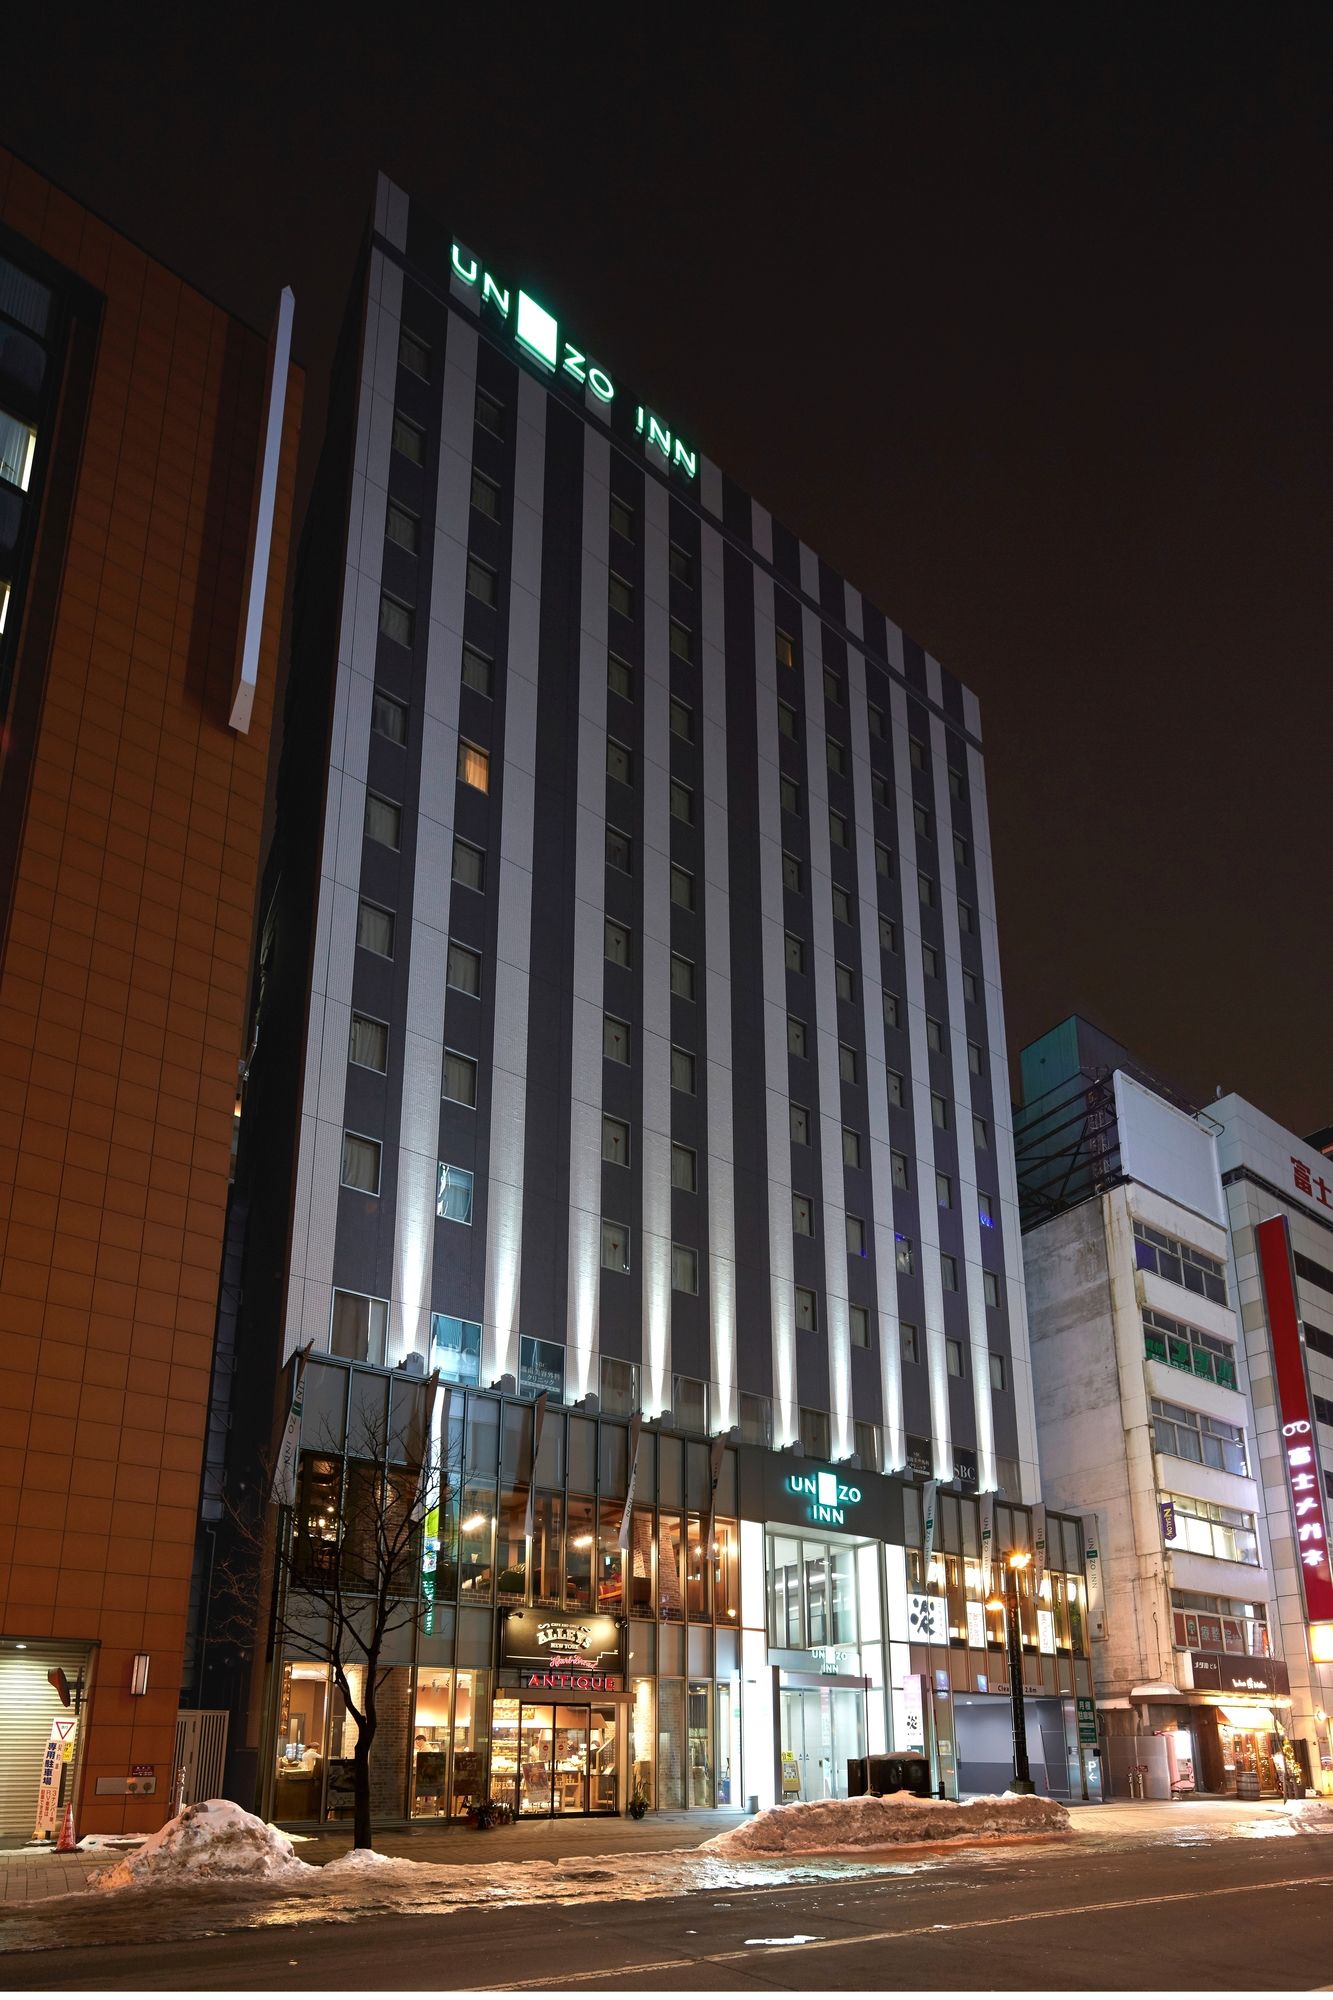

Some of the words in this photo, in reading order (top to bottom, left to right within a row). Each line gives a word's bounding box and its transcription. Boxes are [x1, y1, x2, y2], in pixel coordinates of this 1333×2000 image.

[635, 406, 697, 478] INN
[953, 1464, 976, 1481] SBC
[812, 1505, 844, 1525] INN
[1287, 1446, 1326, 1566] 富士メガネ
[536, 1628, 593, 1649] ALLEYS
[527, 1672, 616, 1691] ANTIQUE
[42, 1742, 57, 1786] 専用駐車場
[1088, 1761, 1096, 1772] P
